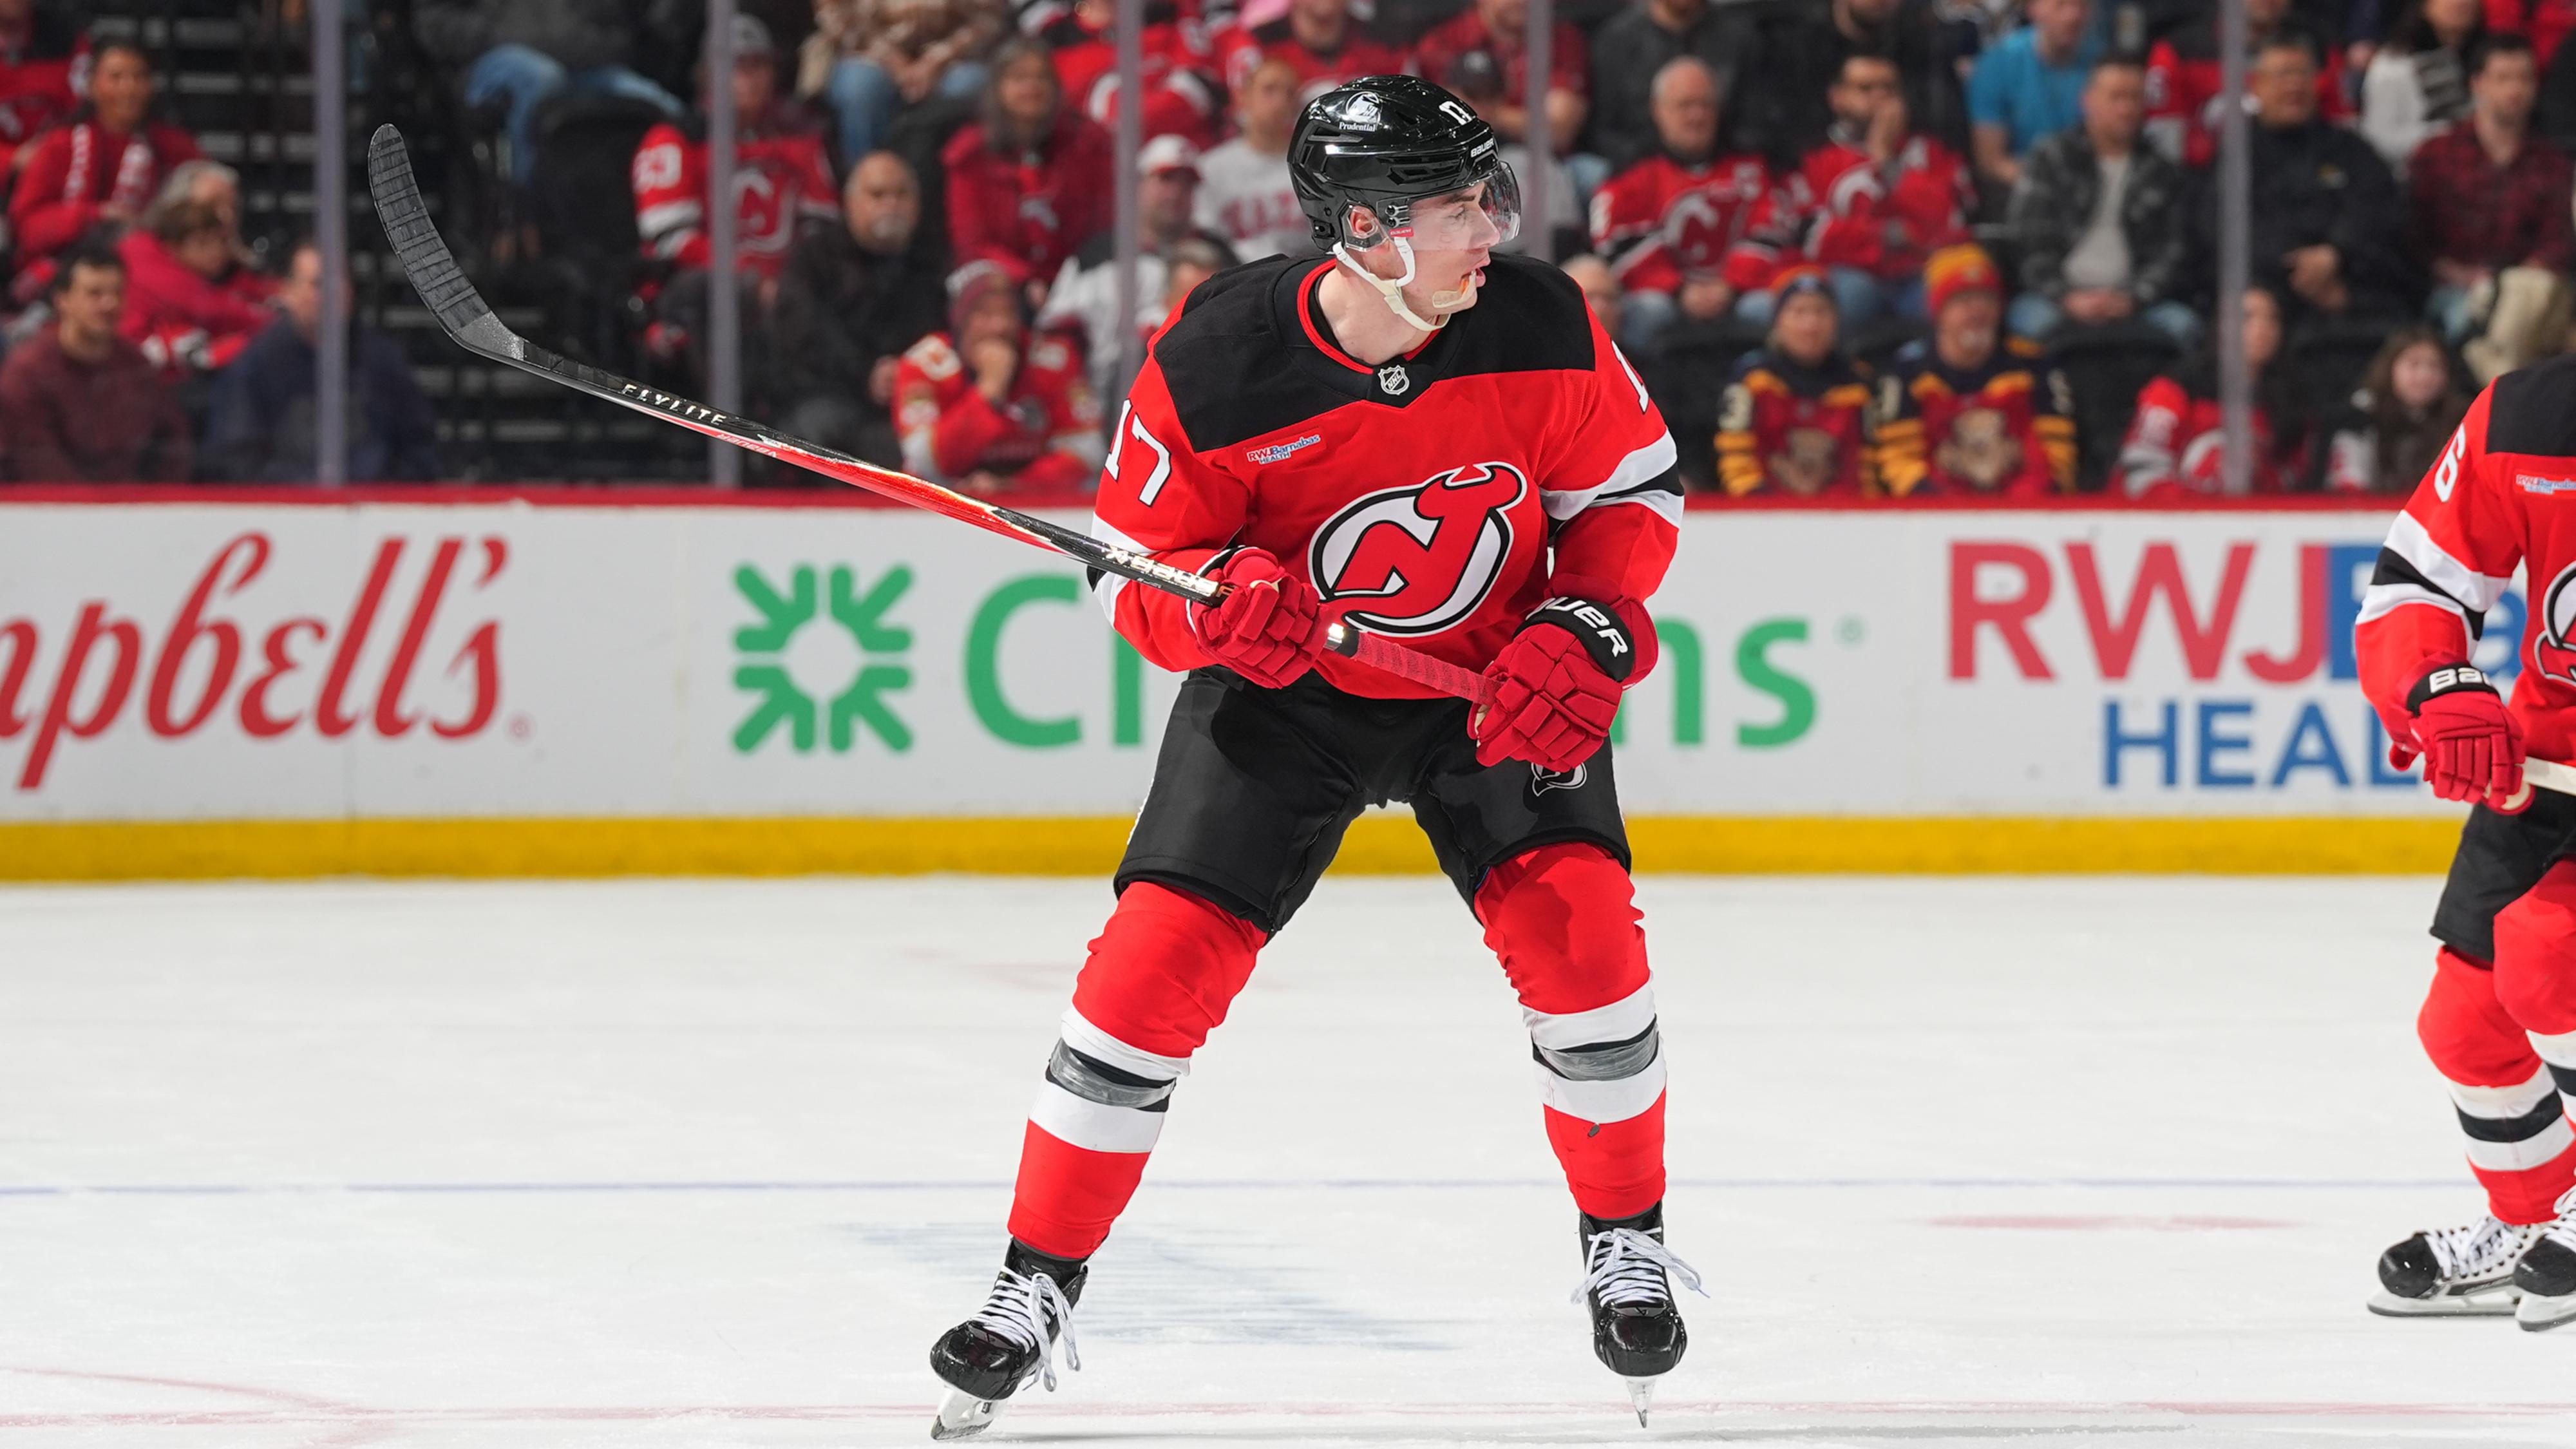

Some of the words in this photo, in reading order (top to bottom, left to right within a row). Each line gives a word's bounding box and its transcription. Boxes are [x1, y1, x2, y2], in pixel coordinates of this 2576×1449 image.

[1340, 121, 1376, 132] Prudential
[622, 383, 727, 426] FLYLITE
[1104, 398, 1172, 507] 17
[1260, 451, 1291, 464] HEALTH
